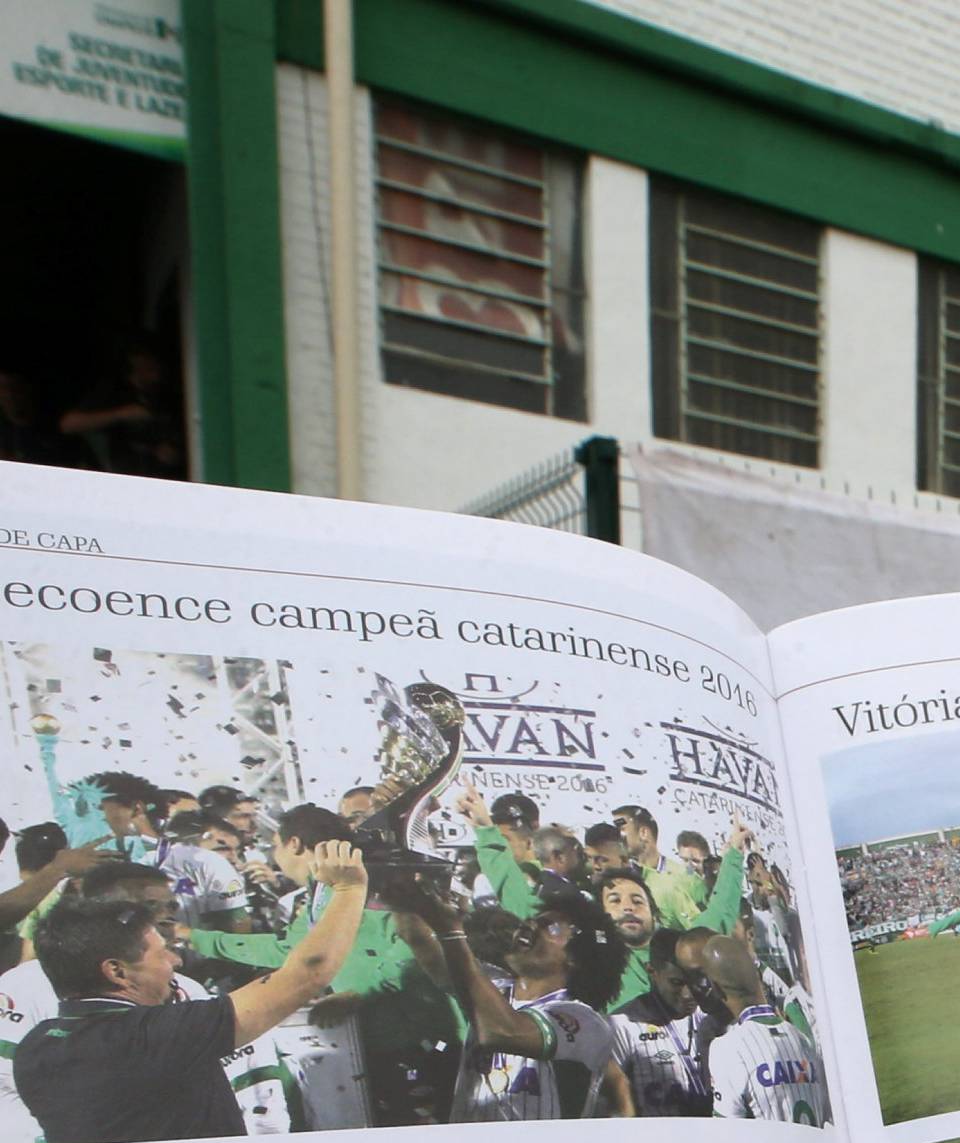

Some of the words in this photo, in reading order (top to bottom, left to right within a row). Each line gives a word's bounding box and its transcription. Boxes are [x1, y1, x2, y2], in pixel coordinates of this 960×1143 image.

[38, 533, 105, 553] CAPA
[4, 582, 231, 623] ecoence
[251, 603, 444, 642] campeã
[458, 620, 690, 683] catarinense
[700, 665, 757, 717] 2016
